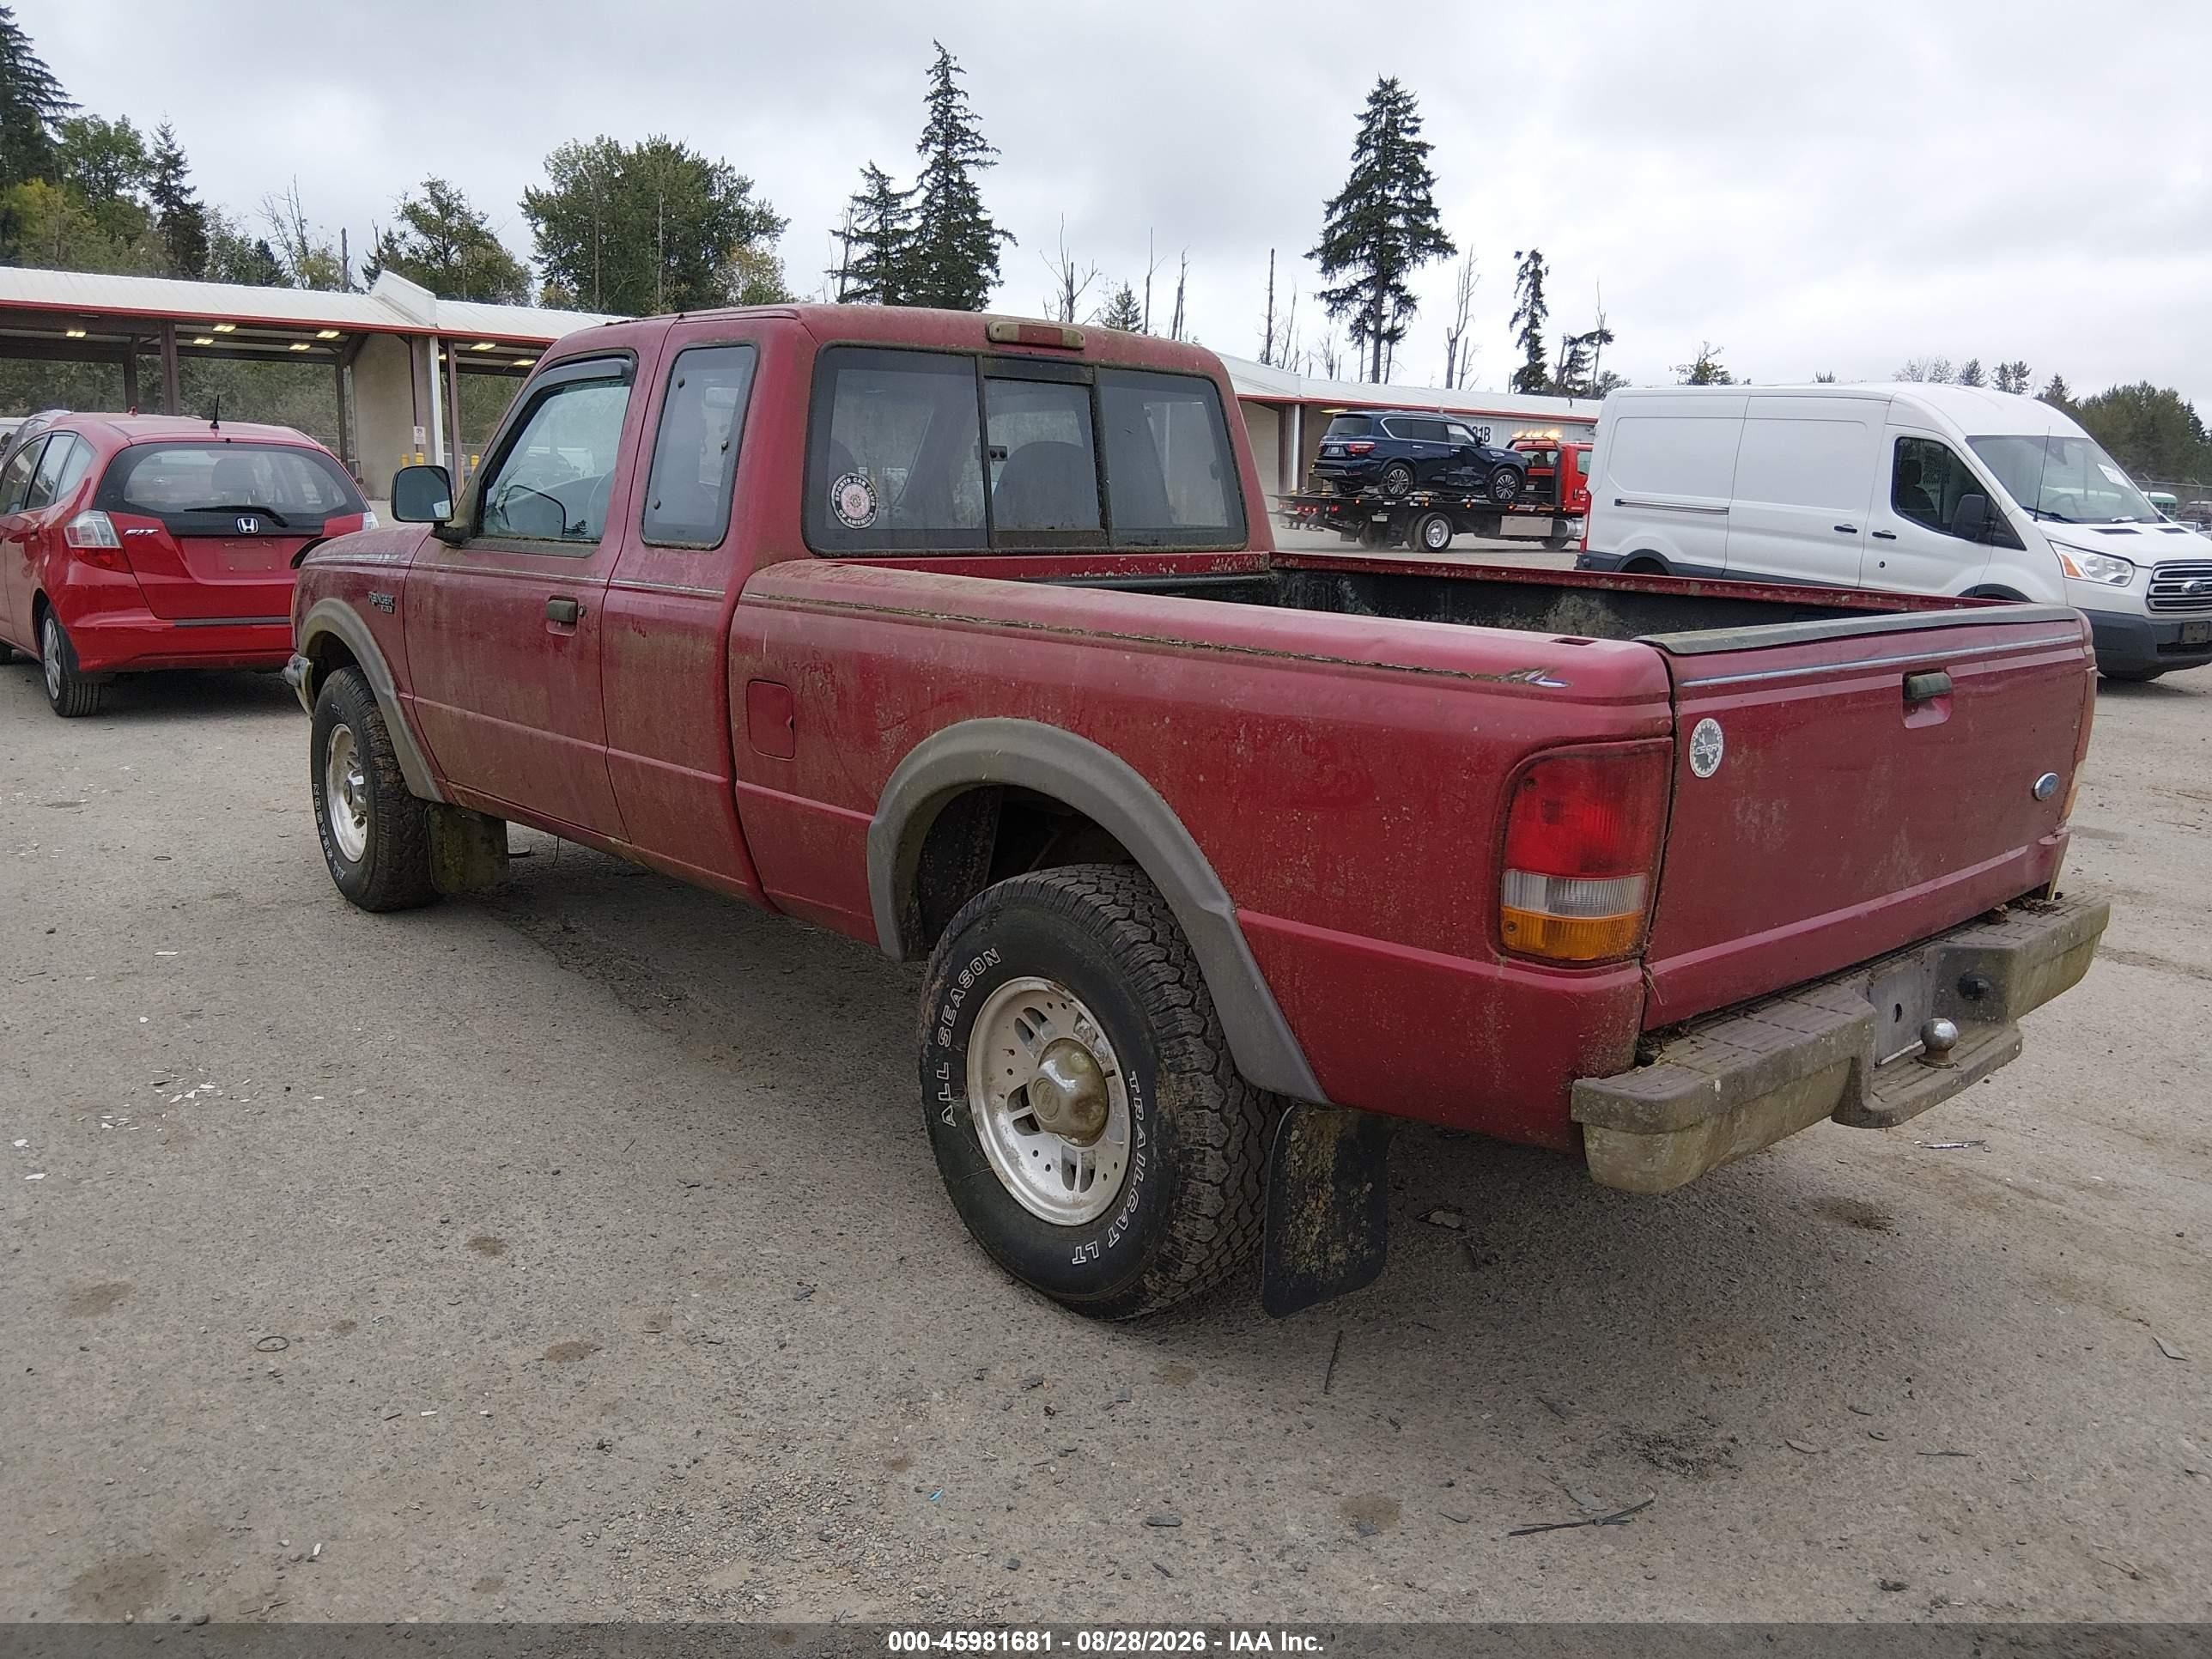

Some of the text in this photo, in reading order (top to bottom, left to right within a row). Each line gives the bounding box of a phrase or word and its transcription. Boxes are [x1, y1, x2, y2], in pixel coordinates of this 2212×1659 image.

[835, 477, 877, 507] SPORTS CAR CLUB
[838, 509, 875, 526] OF AMERICA
[936, 947, 1002, 1127] ALL SEASON
[1072, 1070, 1146, 1265] TRAILCAT LT
